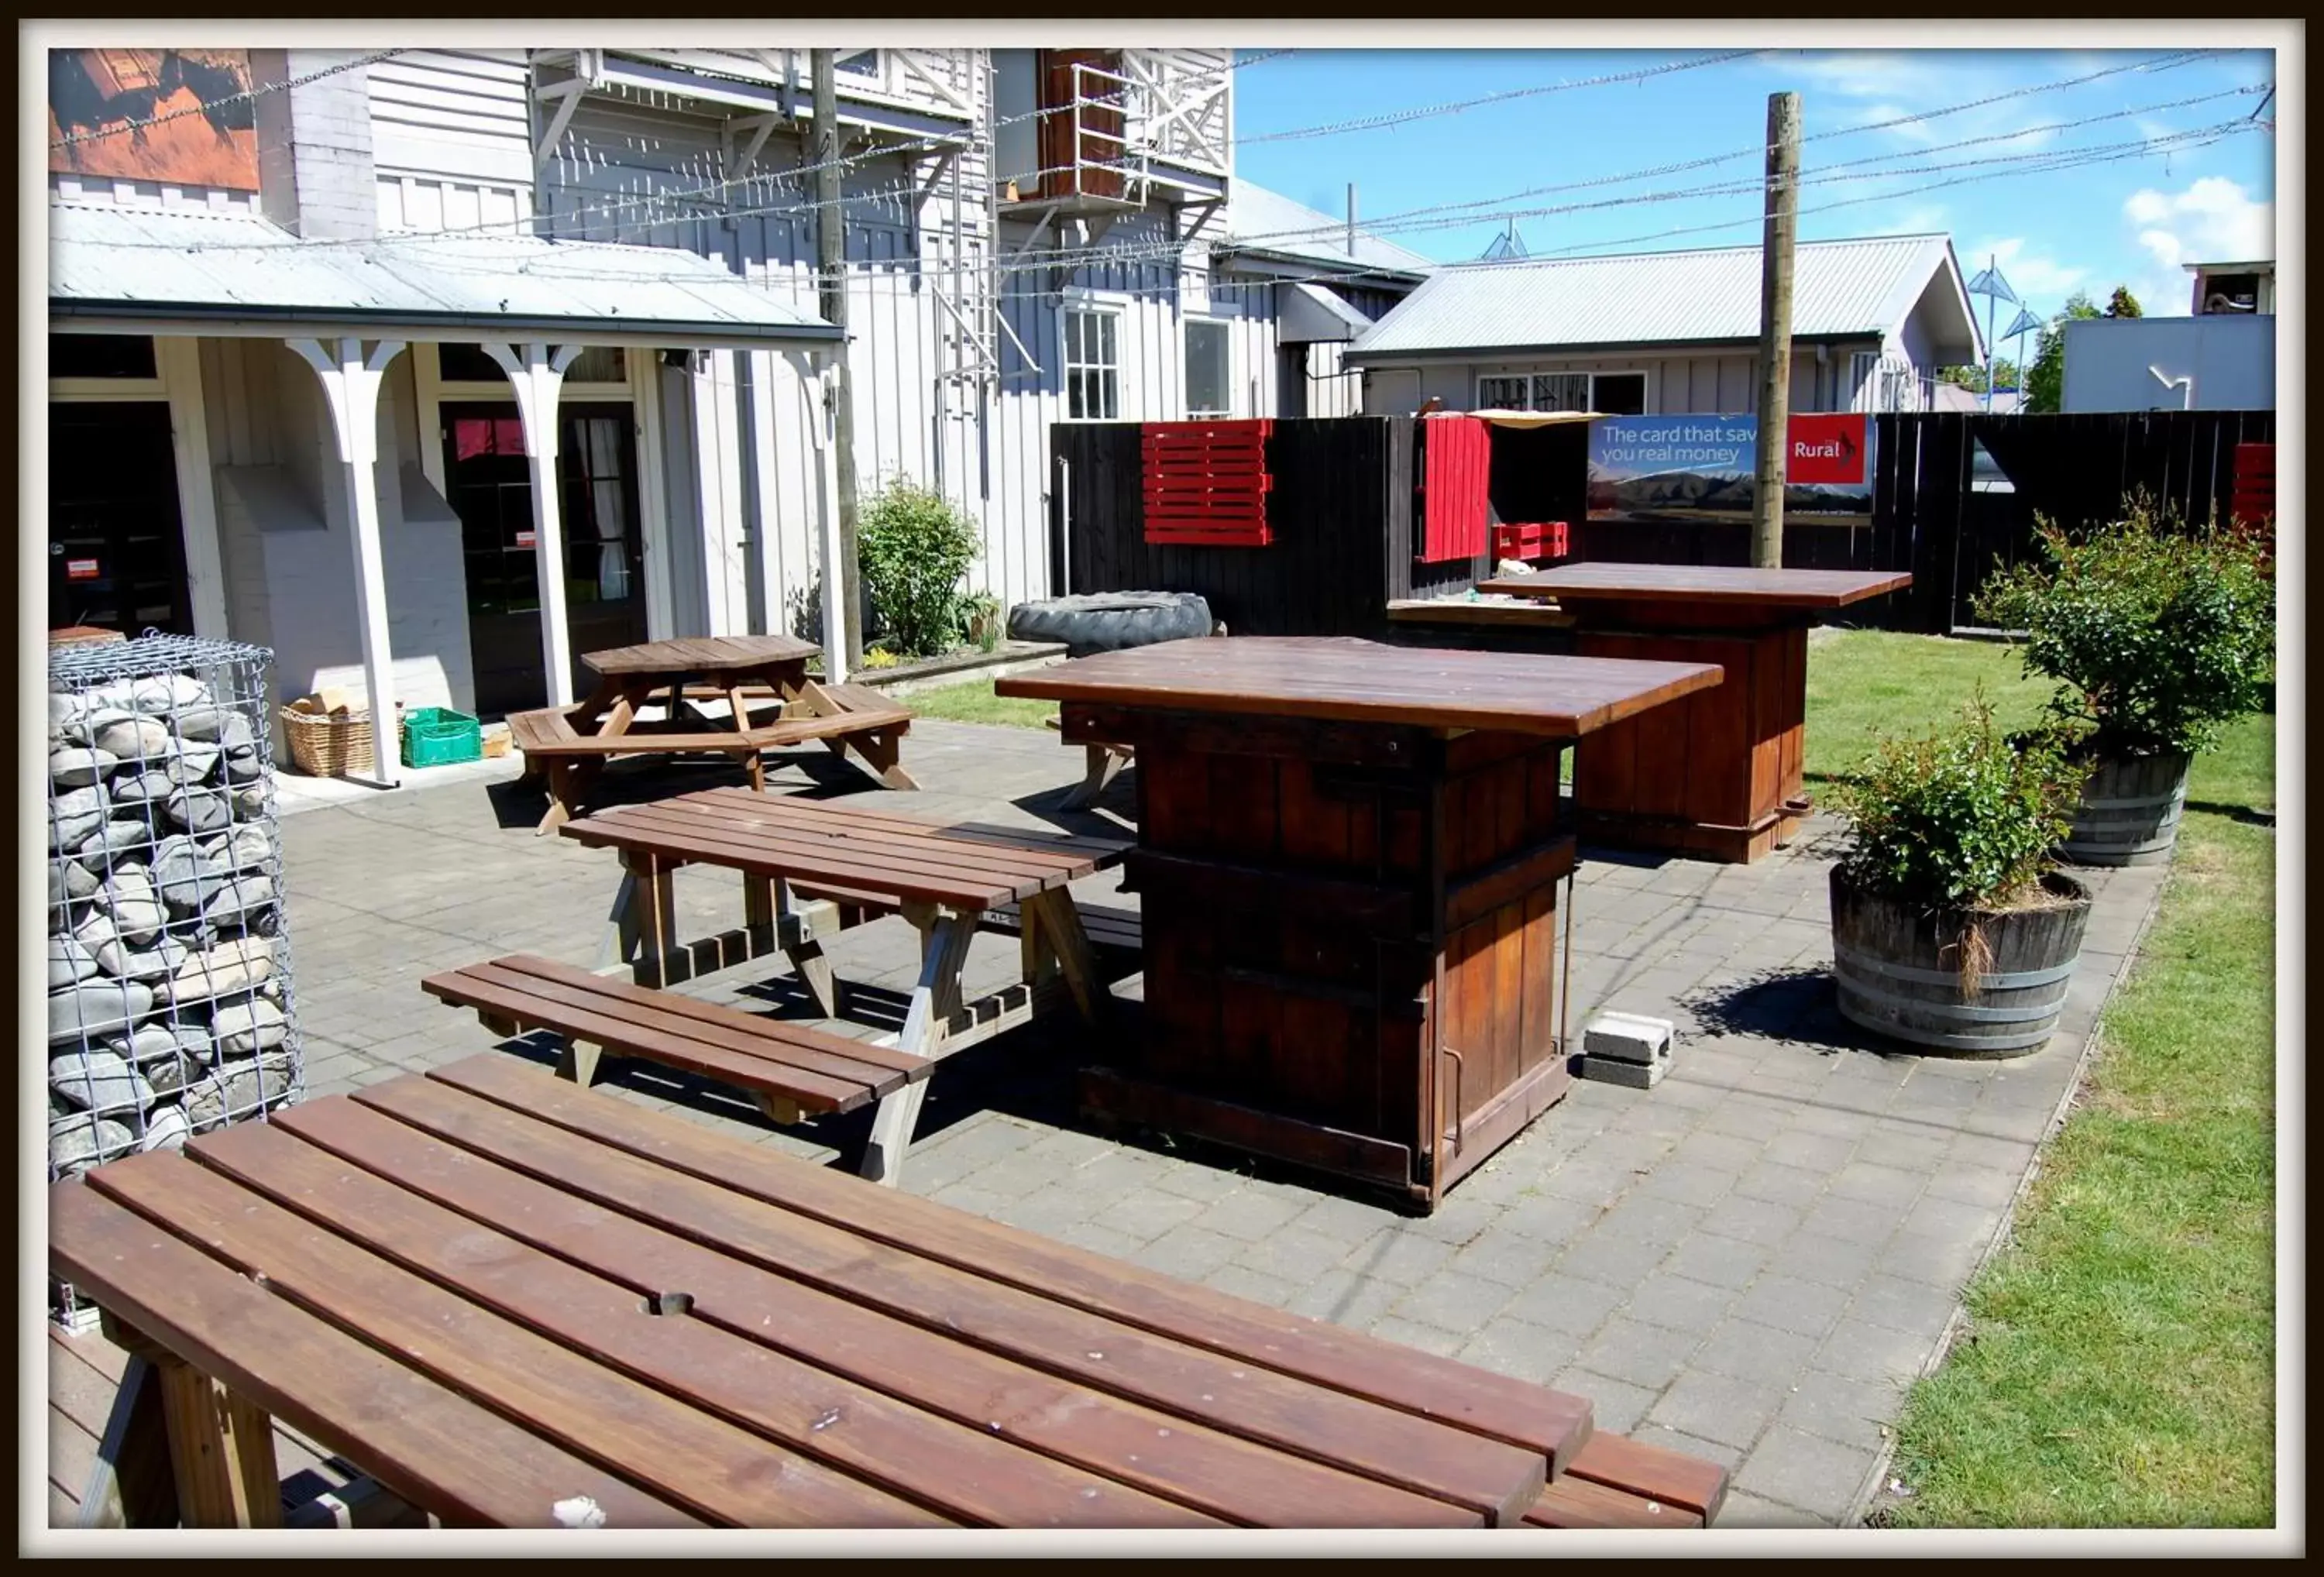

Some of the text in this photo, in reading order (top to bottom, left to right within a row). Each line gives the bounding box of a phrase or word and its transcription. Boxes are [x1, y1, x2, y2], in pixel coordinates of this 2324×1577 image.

[1604, 426, 1757, 443] The card that sav
[1602, 445, 1739, 465] you real money
[1795, 441, 1840, 458] Rural
